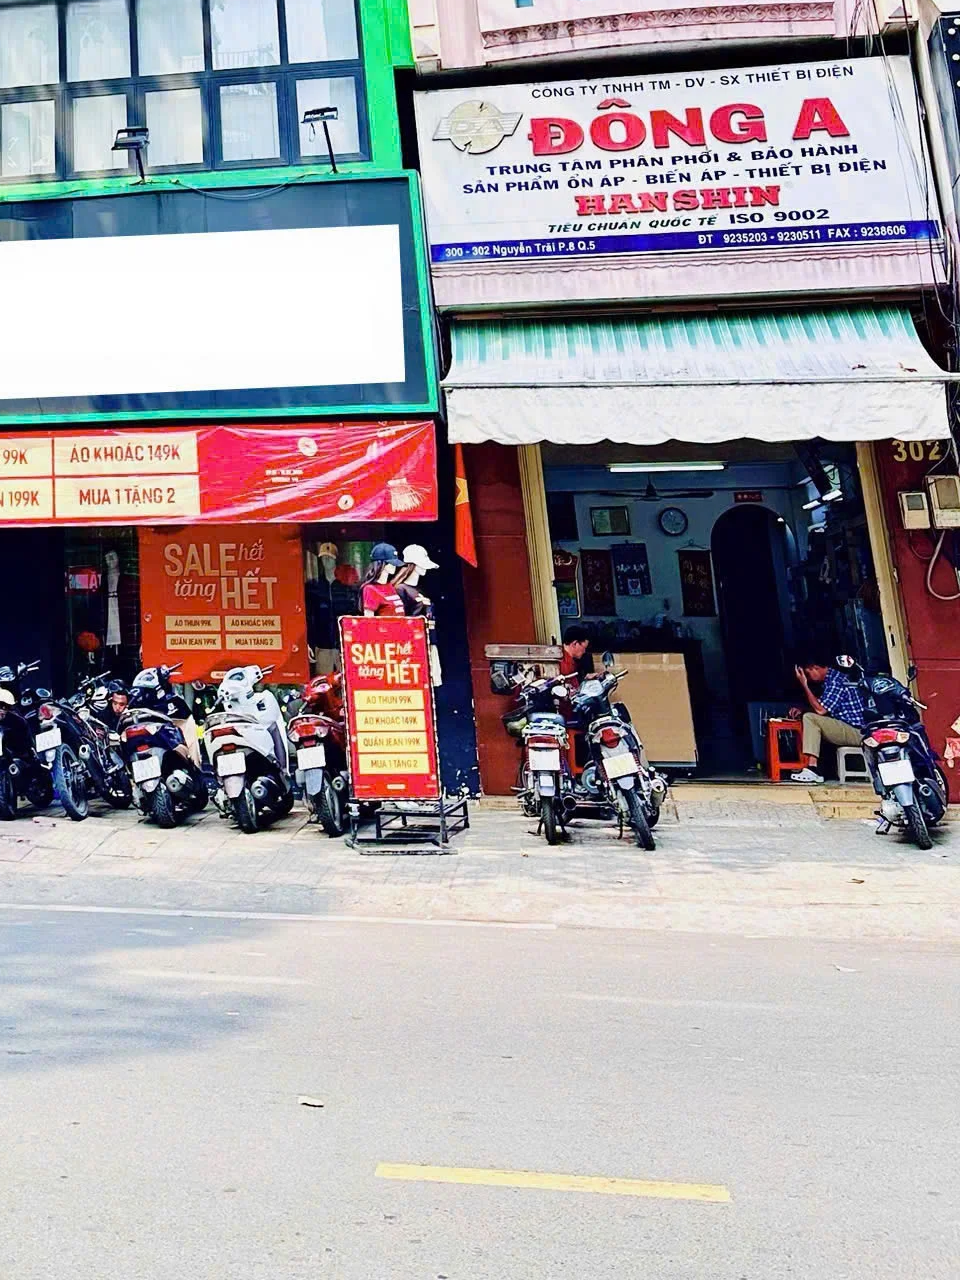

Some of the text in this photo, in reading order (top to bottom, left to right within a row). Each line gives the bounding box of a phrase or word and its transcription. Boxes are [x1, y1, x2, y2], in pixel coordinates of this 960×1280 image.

[531, 85, 575, 99] CÔNG
[579, 84, 598, 96] TY
[602, 81, 644, 95] TNHH
[648, 79, 671, 91] TM
[685, 77, 706, 89] DV
[720, 74, 741, 86] SX
[745, 67, 790, 84] THIẾT
[796, 69, 812, 82] BỊ
[816, 65, 854, 79] ĐIỆN
[527, 97, 851, 156] ĐÔNG A
[486, 144, 858, 176] TRUNG TÂM PHÂN PHỐI & BẢO HÀNH
[463, 180, 499, 194] SẢN
[506, 176, 559, 192] PHẨM
[567, 173, 594, 189] ỔN
[600, 175, 625, 188] ÁP
[645, 169, 691, 185] BIẾN
[701, 168, 727, 182] ÁP
[745, 163, 803, 179] THIẾT
[811, 163, 831, 176] BỊ
[838, 159, 887, 174] ĐIỆN
[574, 185, 781, 216] HANSHIN
[648, 215, 692, 228] QUỐC
[729, 212, 764, 225] ISO
[773, 208, 830, 221] 9002
[445, 247, 464, 257] 300
[472, 245, 490, 256] 302
[492, 241, 532, 258] Nguyễn
[534, 241, 556, 252] Trãi
[558, 241, 575, 251] P.8
[577, 240, 596, 251] Q.5
[698, 233, 714, 245] ĐT
[723, 231, 768, 244] 9235203
[777, 229, 821, 242] 9230511
[828, 226, 851, 239] FAX
[860, 224, 907, 237] 9238606
[3, 448, 28, 465] 99K
[70, 442, 181, 462] ÁO KHOÁC 149K
[891, 439, 941, 463] 302
[8, 490, 40, 507] 199K
[79, 486, 176, 507] MUA 1 TẶNG 2
[164, 538, 265, 577] SALE hết
[174, 567, 278, 610] tặng HẾT
[184, 619, 200, 627] THUN
[351, 642, 396, 665] SALE
[386, 658, 421, 684] HẾT
[378, 696, 398, 704] THUN
[399, 696, 412, 704] 99K
[401, 717, 418, 725] 149K
[385, 738, 404, 746] JEAN
[405, 738, 421, 746] 199K
[371, 760, 387, 768] MUA
[412, 760, 418, 768] 2
